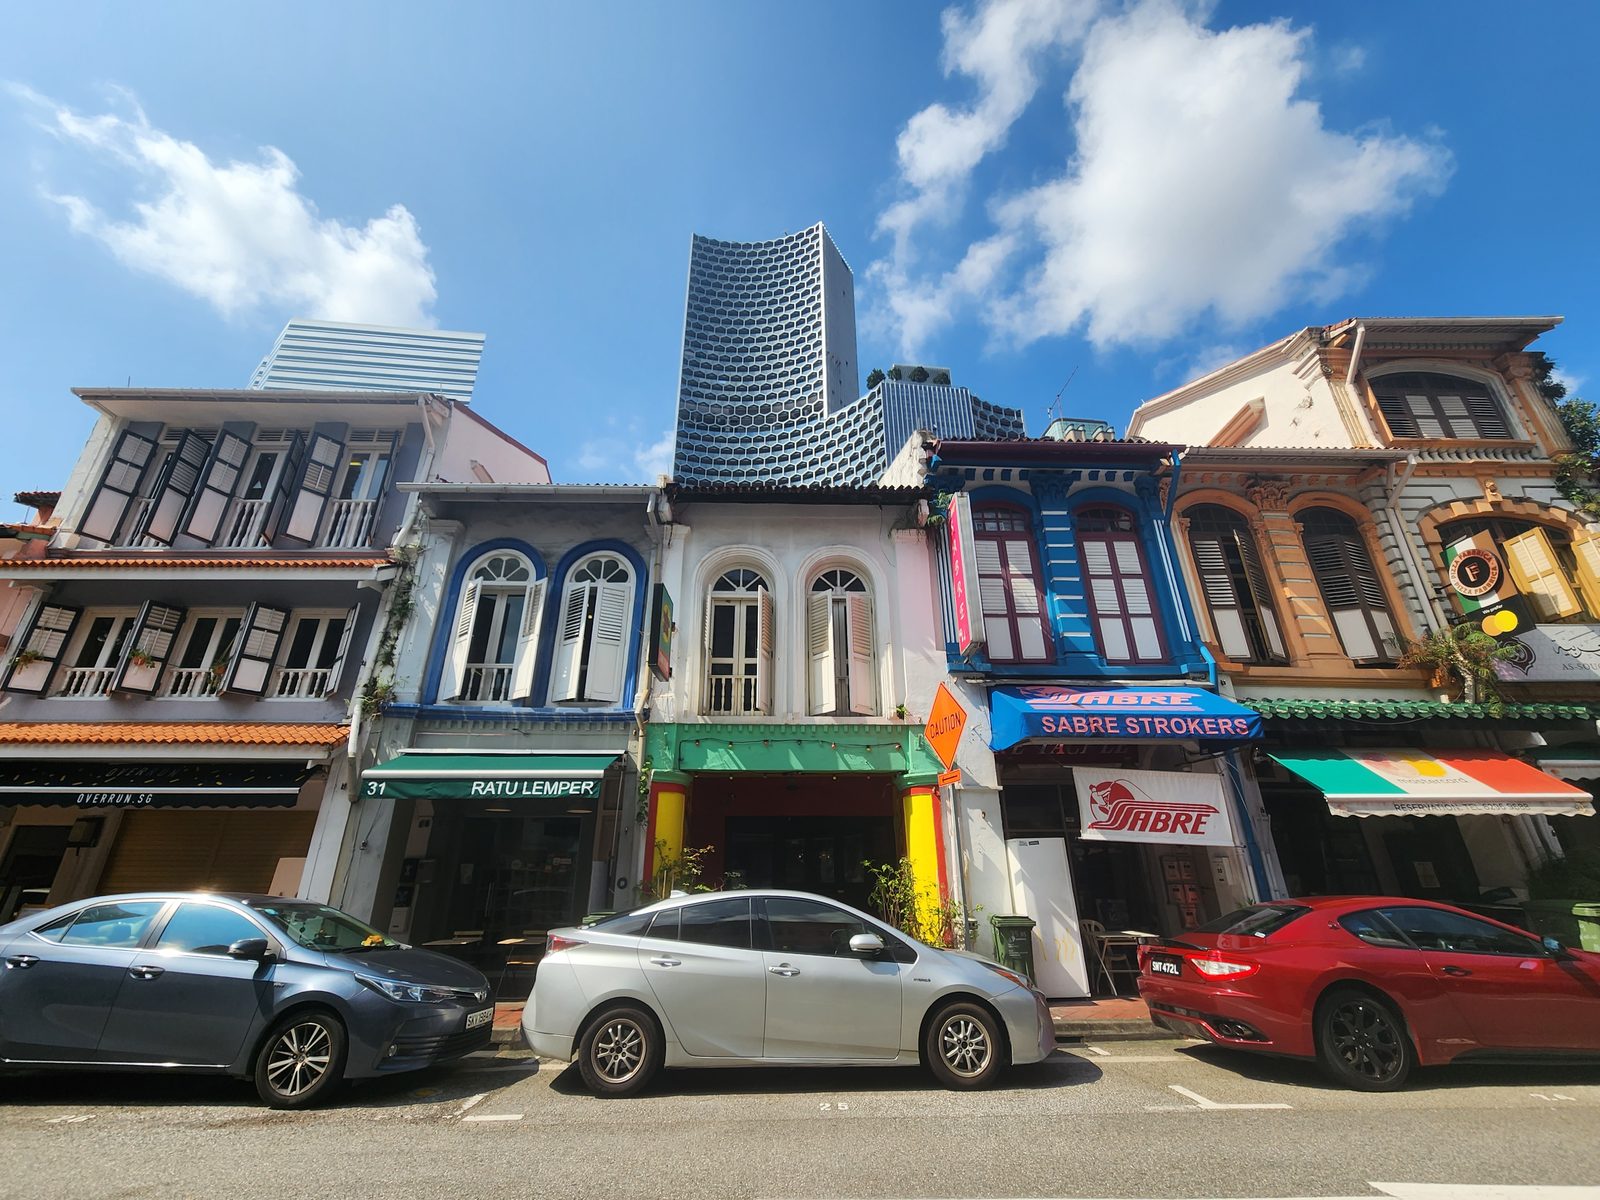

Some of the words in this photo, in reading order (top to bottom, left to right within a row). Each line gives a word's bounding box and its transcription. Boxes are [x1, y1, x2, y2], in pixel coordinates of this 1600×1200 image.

[1562, 663, 1600, 671] AS-SOU
[929, 711, 961, 739] CAUTION
[1041, 716, 1120, 734] SABRE
[1125, 716, 1250, 736] STROKERS
[366, 781, 387, 796] 31
[471, 781, 518, 796] RATU
[521, 781, 594, 796] LEMPER
[76, 793, 153, 804] OVERRUN.SG
[1088, 800, 1212, 835] SABRE
